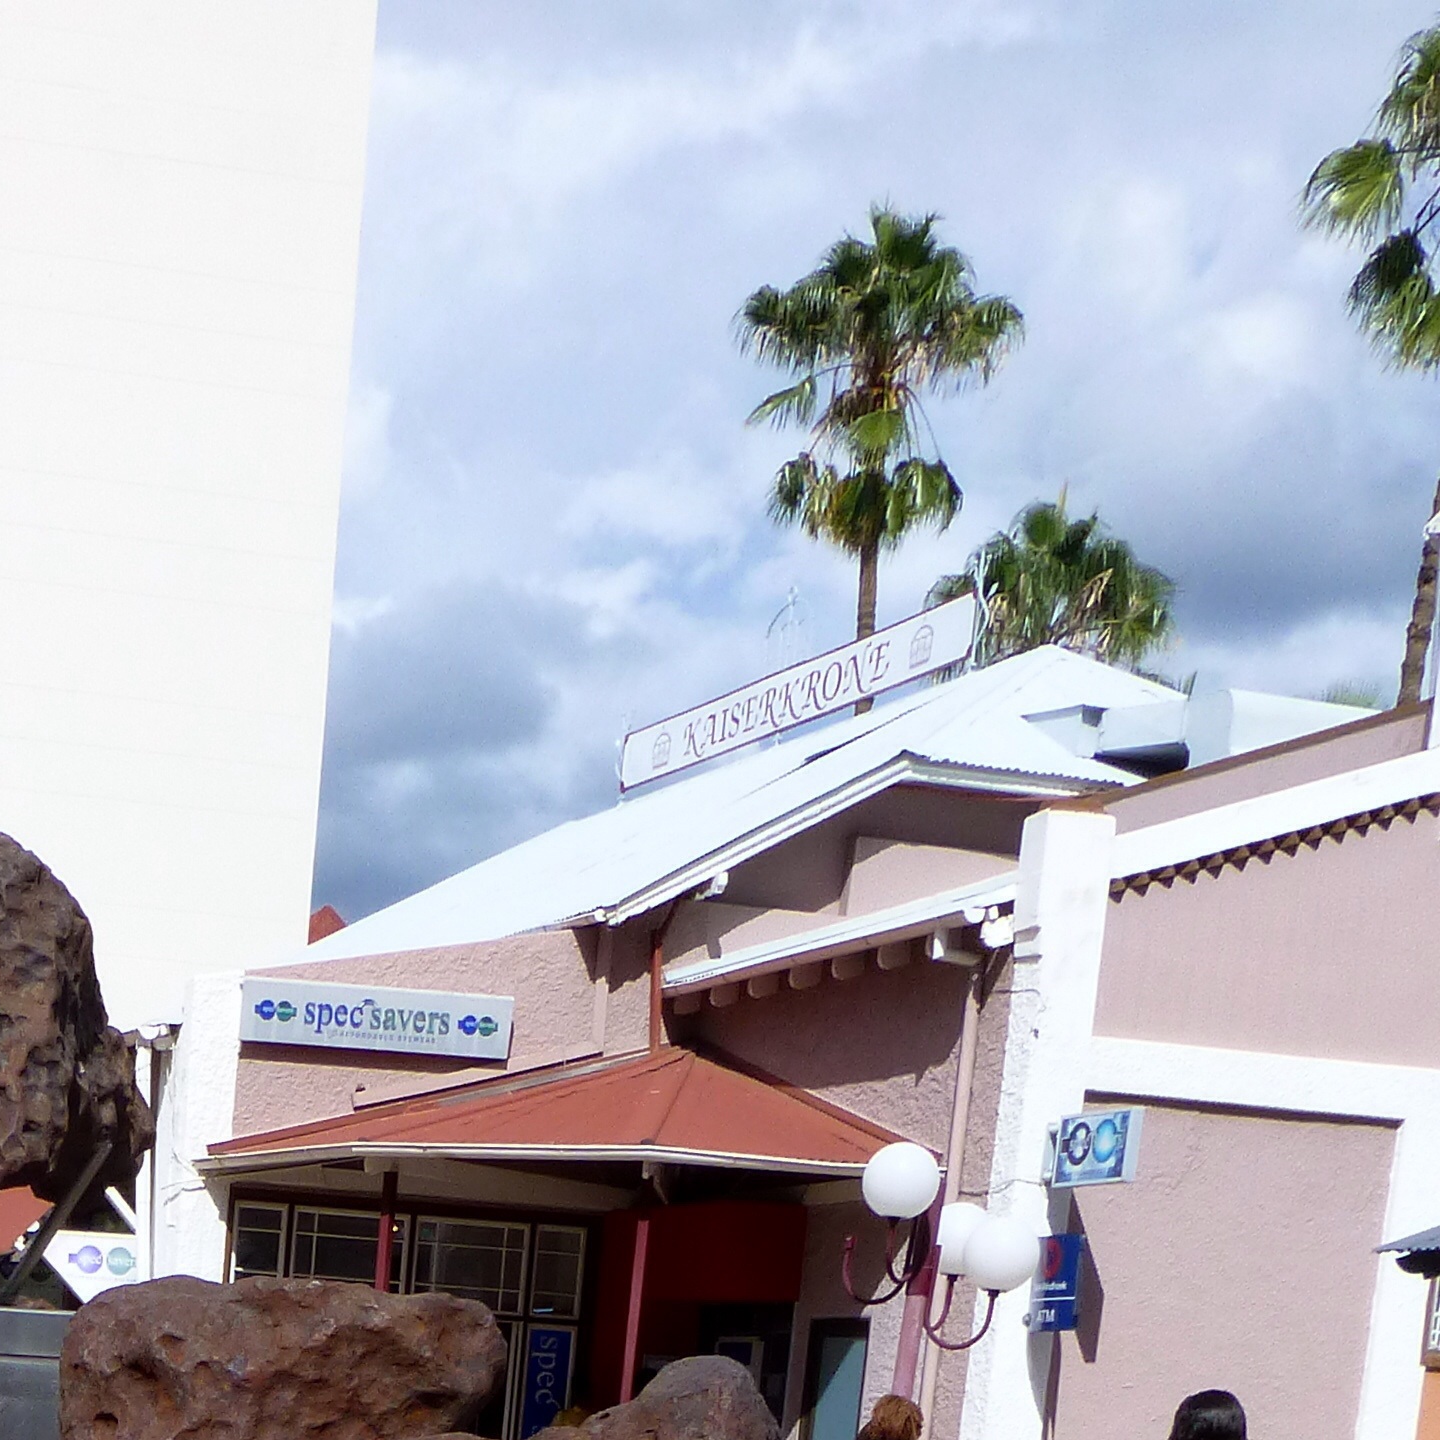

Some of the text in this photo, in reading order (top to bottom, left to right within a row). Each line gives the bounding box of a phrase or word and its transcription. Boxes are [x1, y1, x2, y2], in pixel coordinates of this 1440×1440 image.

[683, 640, 891, 758] KAISERKRONE
[303, 1001, 451, 1036] spec savers
